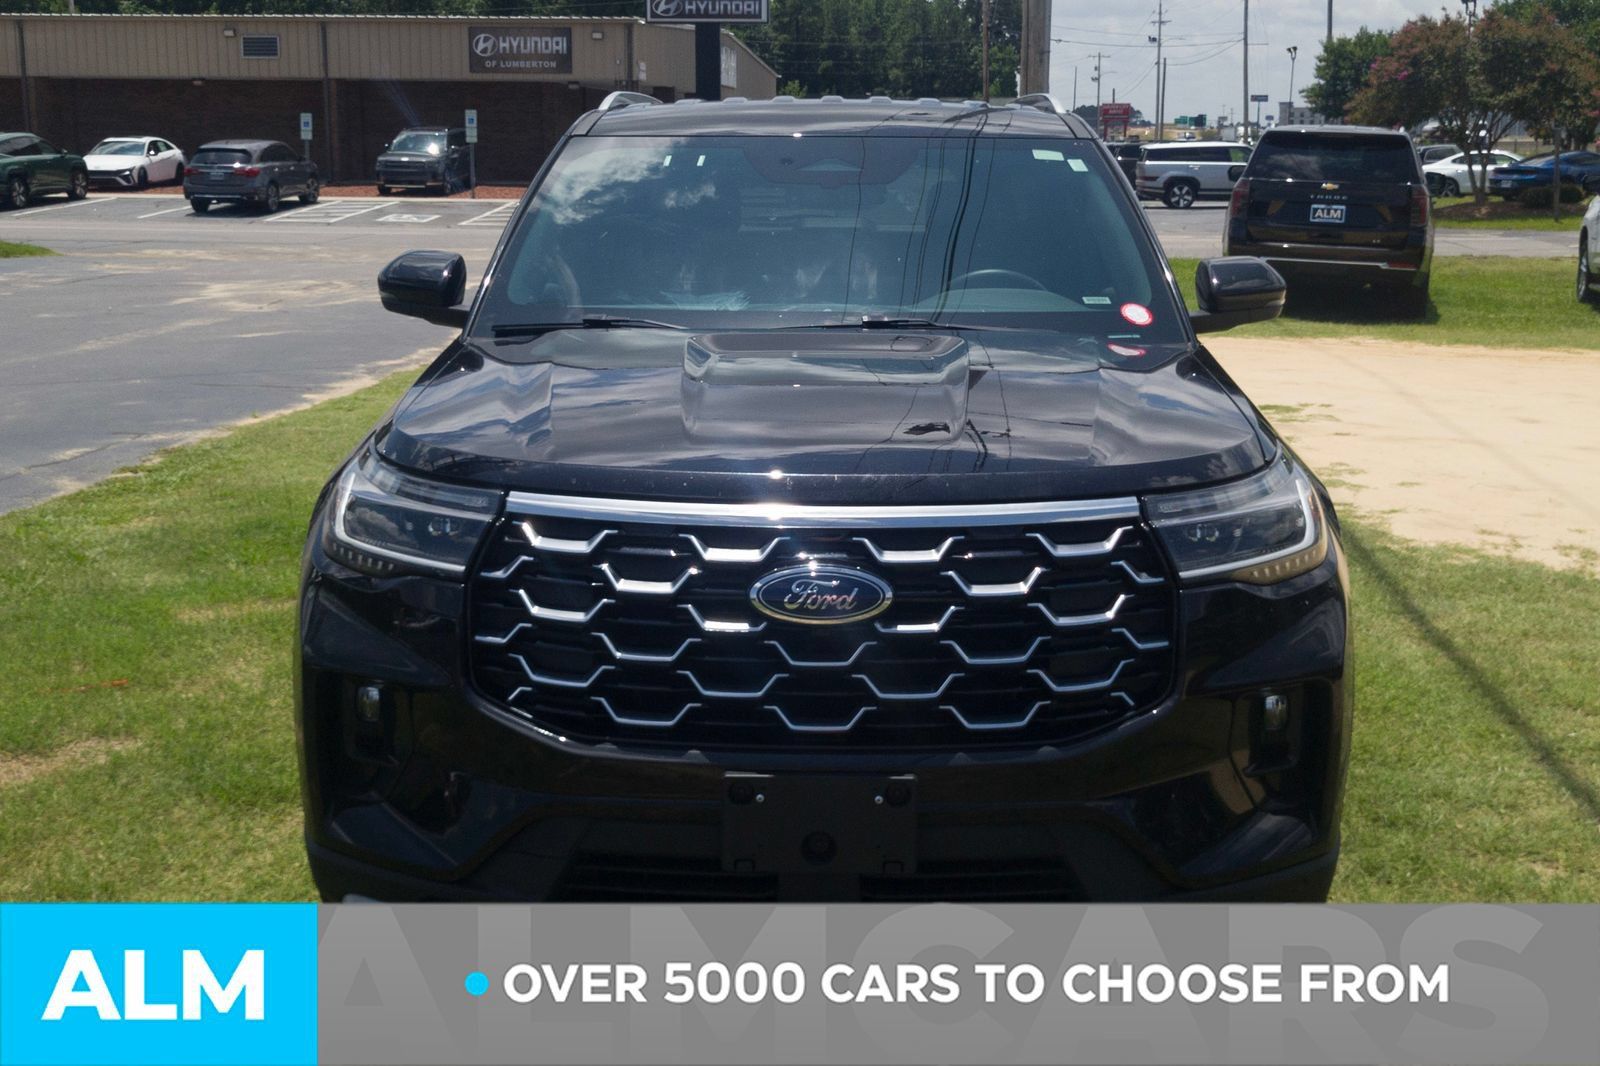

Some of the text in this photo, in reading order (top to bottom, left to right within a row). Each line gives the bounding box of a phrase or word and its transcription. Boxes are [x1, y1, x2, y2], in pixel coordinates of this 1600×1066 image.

[685, 0, 760, 15] HYUNDAI
[499, 36, 567, 54] HYUNDAI
[485, 60, 557, 68] OF LUMBERTON
[1314, 208, 1342, 219] ALM
[783, 578, 859, 610] Ford
